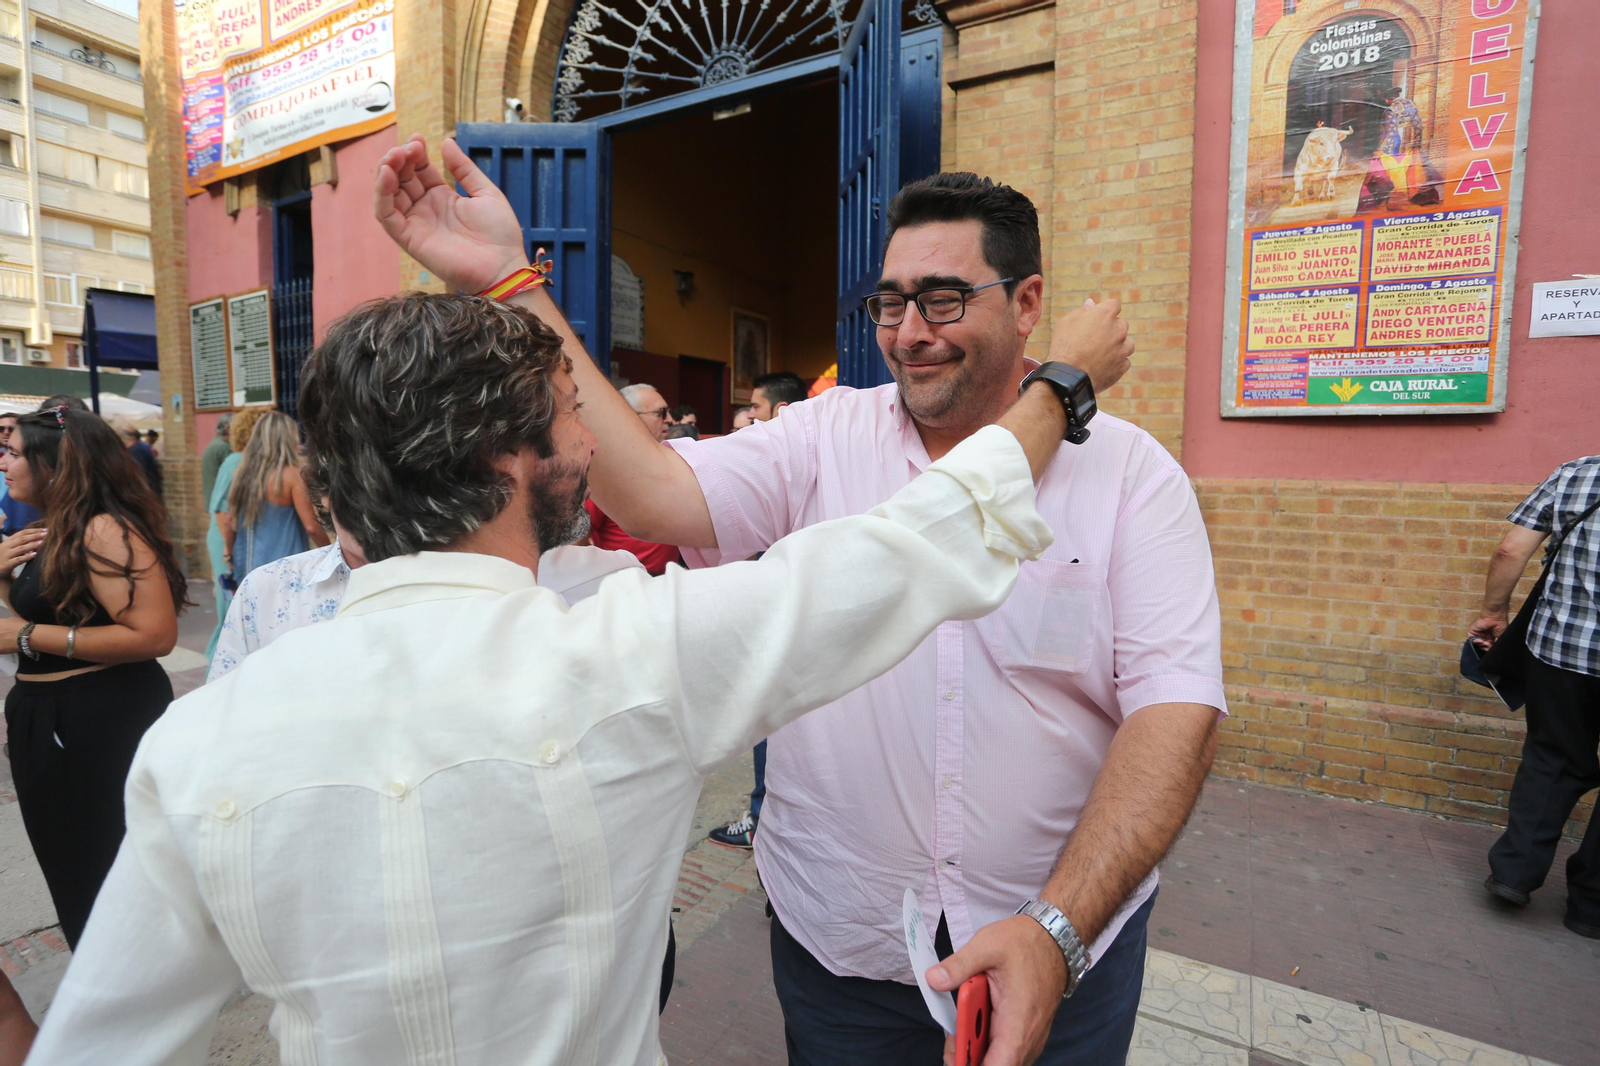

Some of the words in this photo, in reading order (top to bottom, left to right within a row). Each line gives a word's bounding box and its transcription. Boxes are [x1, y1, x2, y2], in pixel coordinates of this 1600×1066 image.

[1326, 19, 1377, 39] Fiestas
[302, 27, 330, 48] LOS
[1310, 30, 1391, 54] Colombinas
[262, 60, 293, 81] 959
[299, 48, 319, 67] 28
[326, 35, 345, 54] 15
[351, 21, 377, 42] 00
[1318, 45, 1380, 72] 2018
[1383, 215, 1430, 226] Viernes,
[1433, 212, 1444, 221] 3
[1447, 208, 1490, 220] Agosto
[1405, 222, 1443, 231] Corrida
[1464, 217, 1494, 226] Toros
[1262, 230, 1300, 239] Jueves,
[1303, 226, 1314, 235] 2
[1315, 223, 1352, 234] Agosto
[1322, 232, 1358, 240] Picadores
[1376, 238, 1433, 251] MORANTE
[1443, 232, 1492, 246] PUEBLA
[1255, 251, 1297, 263] EMILIO
[1303, 245, 1358, 259] SILVERA
[1398, 244, 1491, 261] MANZANARES
[1254, 264, 1271, 274] Juan
[1272, 263, 1289, 273] Silva
[1374, 263, 1412, 274] DAVID
[1427, 256, 1490, 271] MIRANDA
[1254, 275, 1294, 285] ALFONSO
[1298, 268, 1356, 281] CADAVAL
[1376, 281, 1427, 292] Domingo,
[1430, 280, 1441, 288] 5
[1444, 277, 1487, 288] Agosto
[1448, 287, 1487, 296] Rejones
[1259, 291, 1298, 300] Sábado,
[1300, 289, 1310, 297] 4
[1312, 288, 1349, 297] Agosto
[1546, 287, 1600, 299] RESERV
[1372, 308, 1401, 317] ANDY
[1405, 301, 1486, 316] CARTAGENA
[1573, 300, 1581, 308] Y
[1299, 321, 1350, 333] PERERA
[1371, 318, 1412, 329] DIEGO
[1417, 313, 1486, 327] VENTURA
[1265, 335, 1302, 345] ROCA
[1308, 333, 1336, 343] REY
[1370, 329, 1421, 340] ANDRES
[1425, 325, 1485, 338] ROMERO
[1308, 351, 1396, 360] MANTENEMOS
[1429, 347, 1490, 356] PRECIOS
[1450, 355, 1474, 363] 00
[1370, 380, 1404, 392] CAJA
[1407, 379, 1458, 391] RURAL
[1393, 392, 1410, 400] DEL
[1412, 392, 1431, 400] SUR
